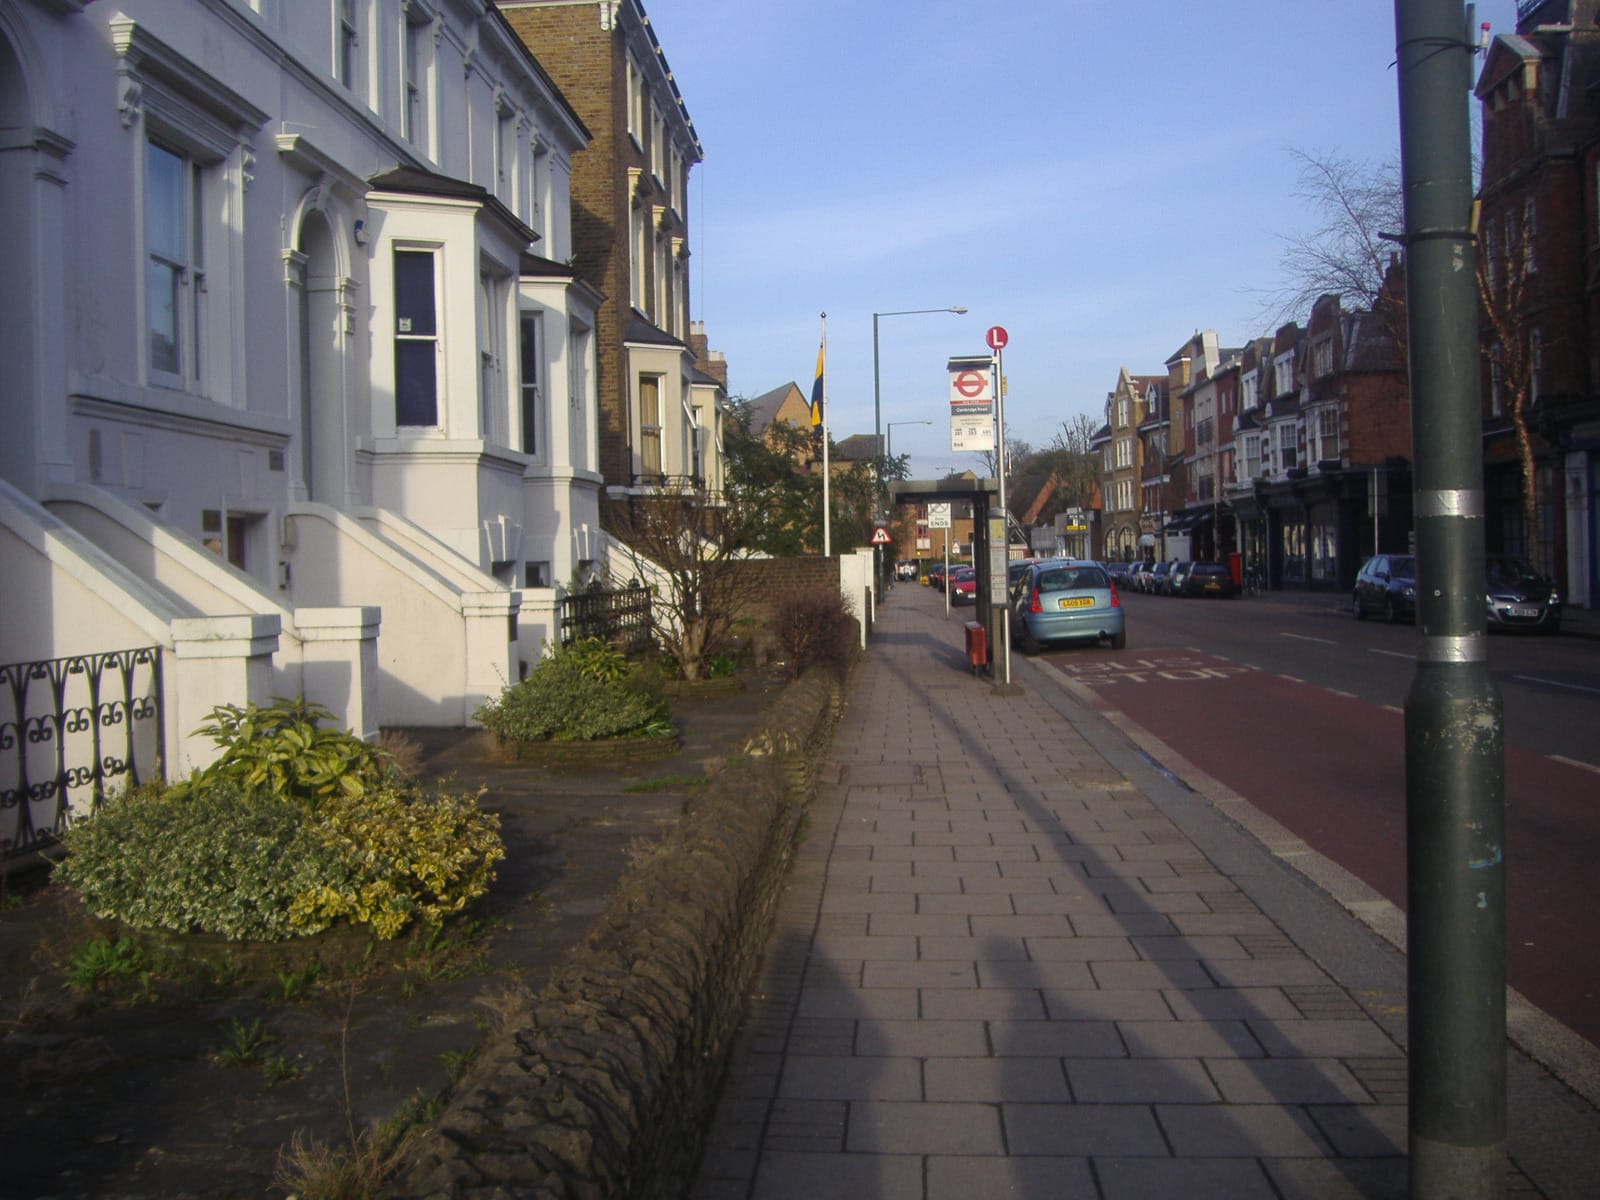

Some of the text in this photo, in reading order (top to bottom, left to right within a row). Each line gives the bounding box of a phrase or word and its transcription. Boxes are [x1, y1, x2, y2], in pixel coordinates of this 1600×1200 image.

[993, 329, 1003, 346] L
[1064, 657, 1204, 673] BUS
[1072, 667, 1249, 685] STOP
